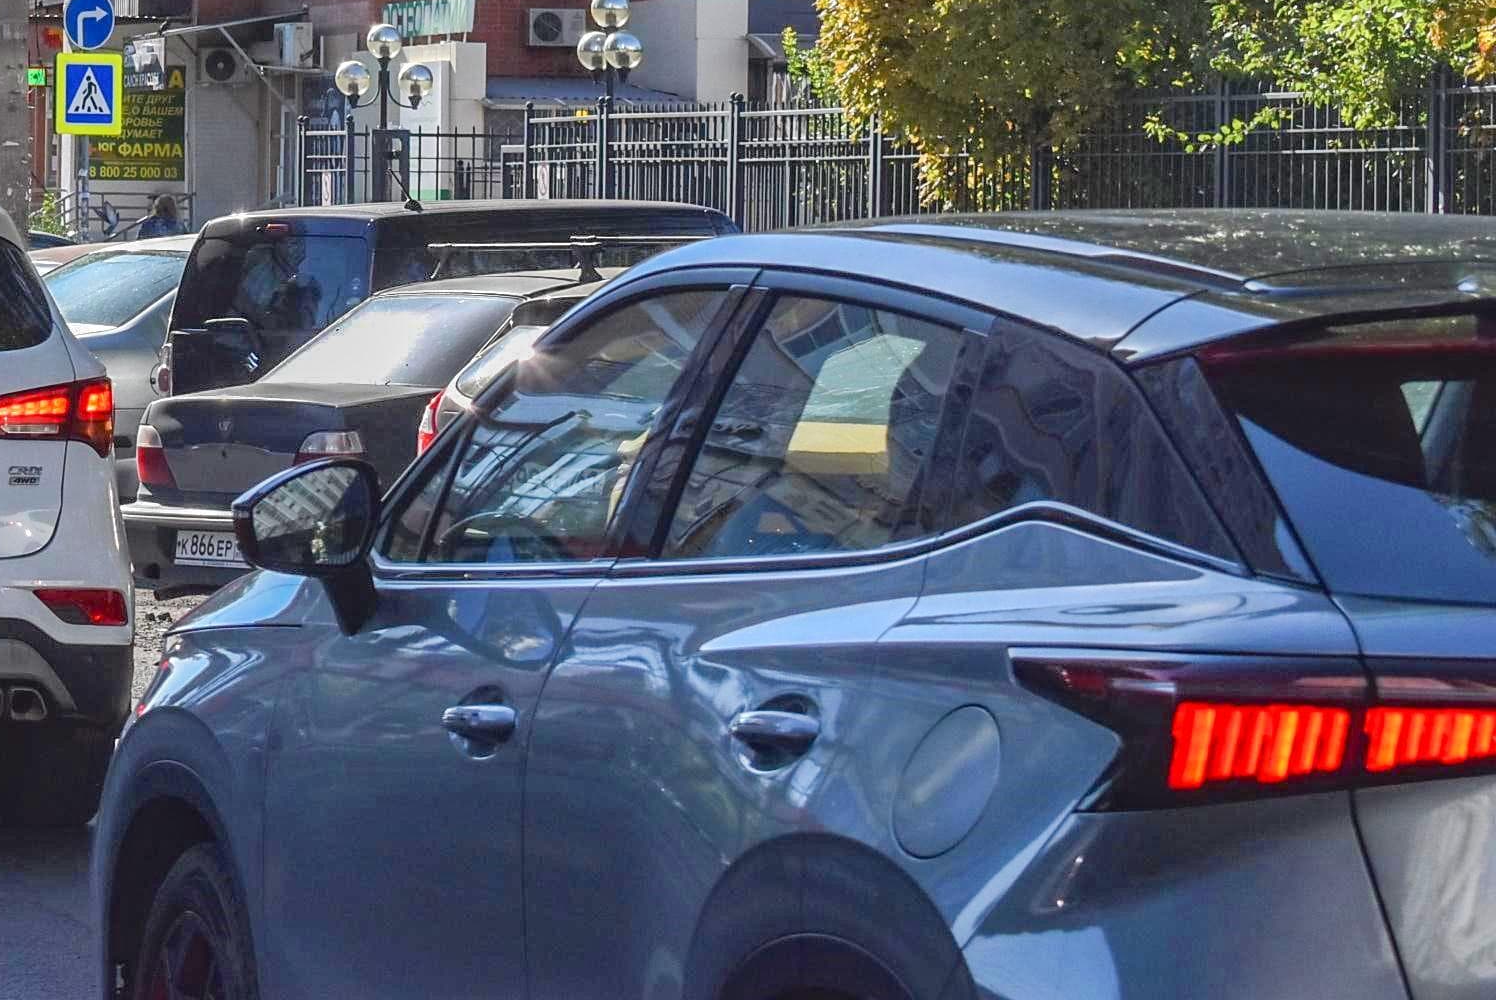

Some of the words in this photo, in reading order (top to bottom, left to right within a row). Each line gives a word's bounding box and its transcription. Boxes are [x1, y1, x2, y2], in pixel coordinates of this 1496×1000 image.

[118, 142, 183, 158] ФАРМА
[89, 165, 97, 177] 8
[99, 166, 120, 178] 800
[123, 166, 137, 178] 25
[140, 167, 161, 178] 000
[164, 167, 178, 178] 03
[180, 534, 233, 557] К866ЕР
